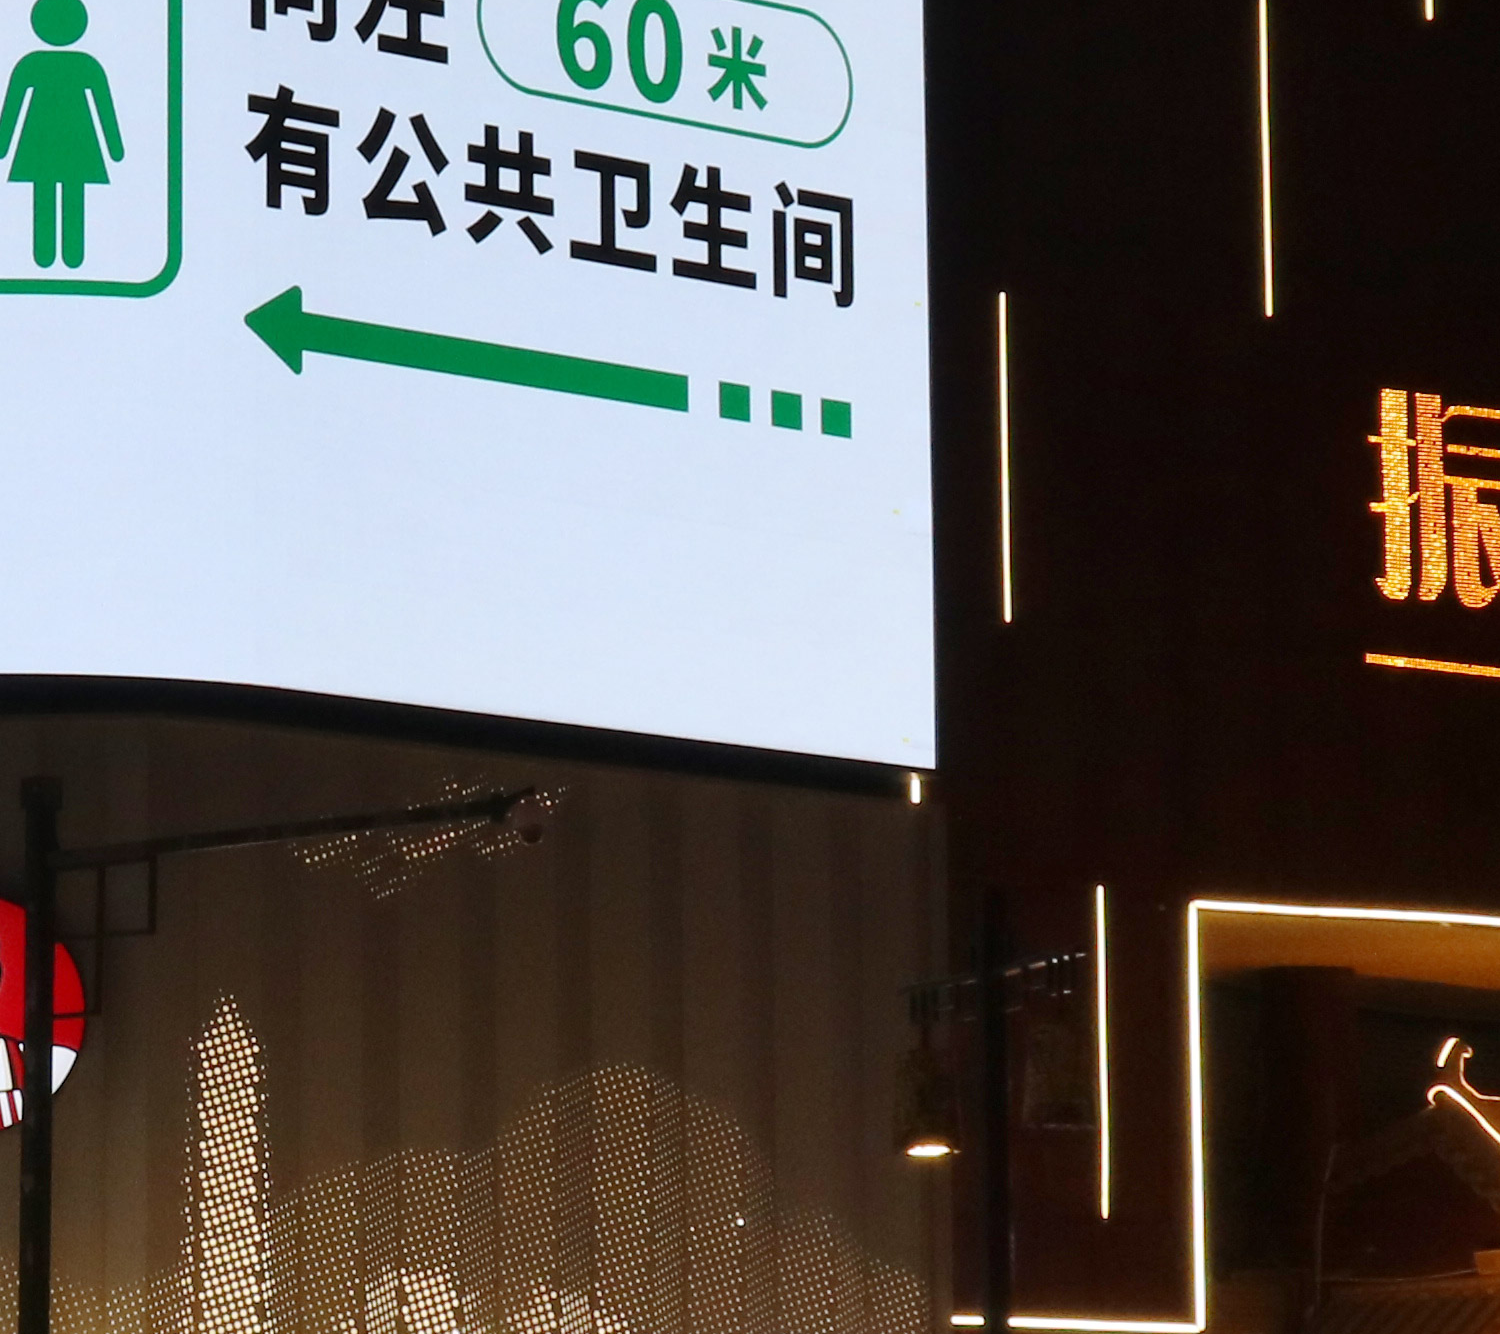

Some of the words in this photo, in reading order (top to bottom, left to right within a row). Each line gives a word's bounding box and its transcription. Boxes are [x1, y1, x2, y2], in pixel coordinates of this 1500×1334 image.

[245, 85, 856, 308] 有公共卫生间
